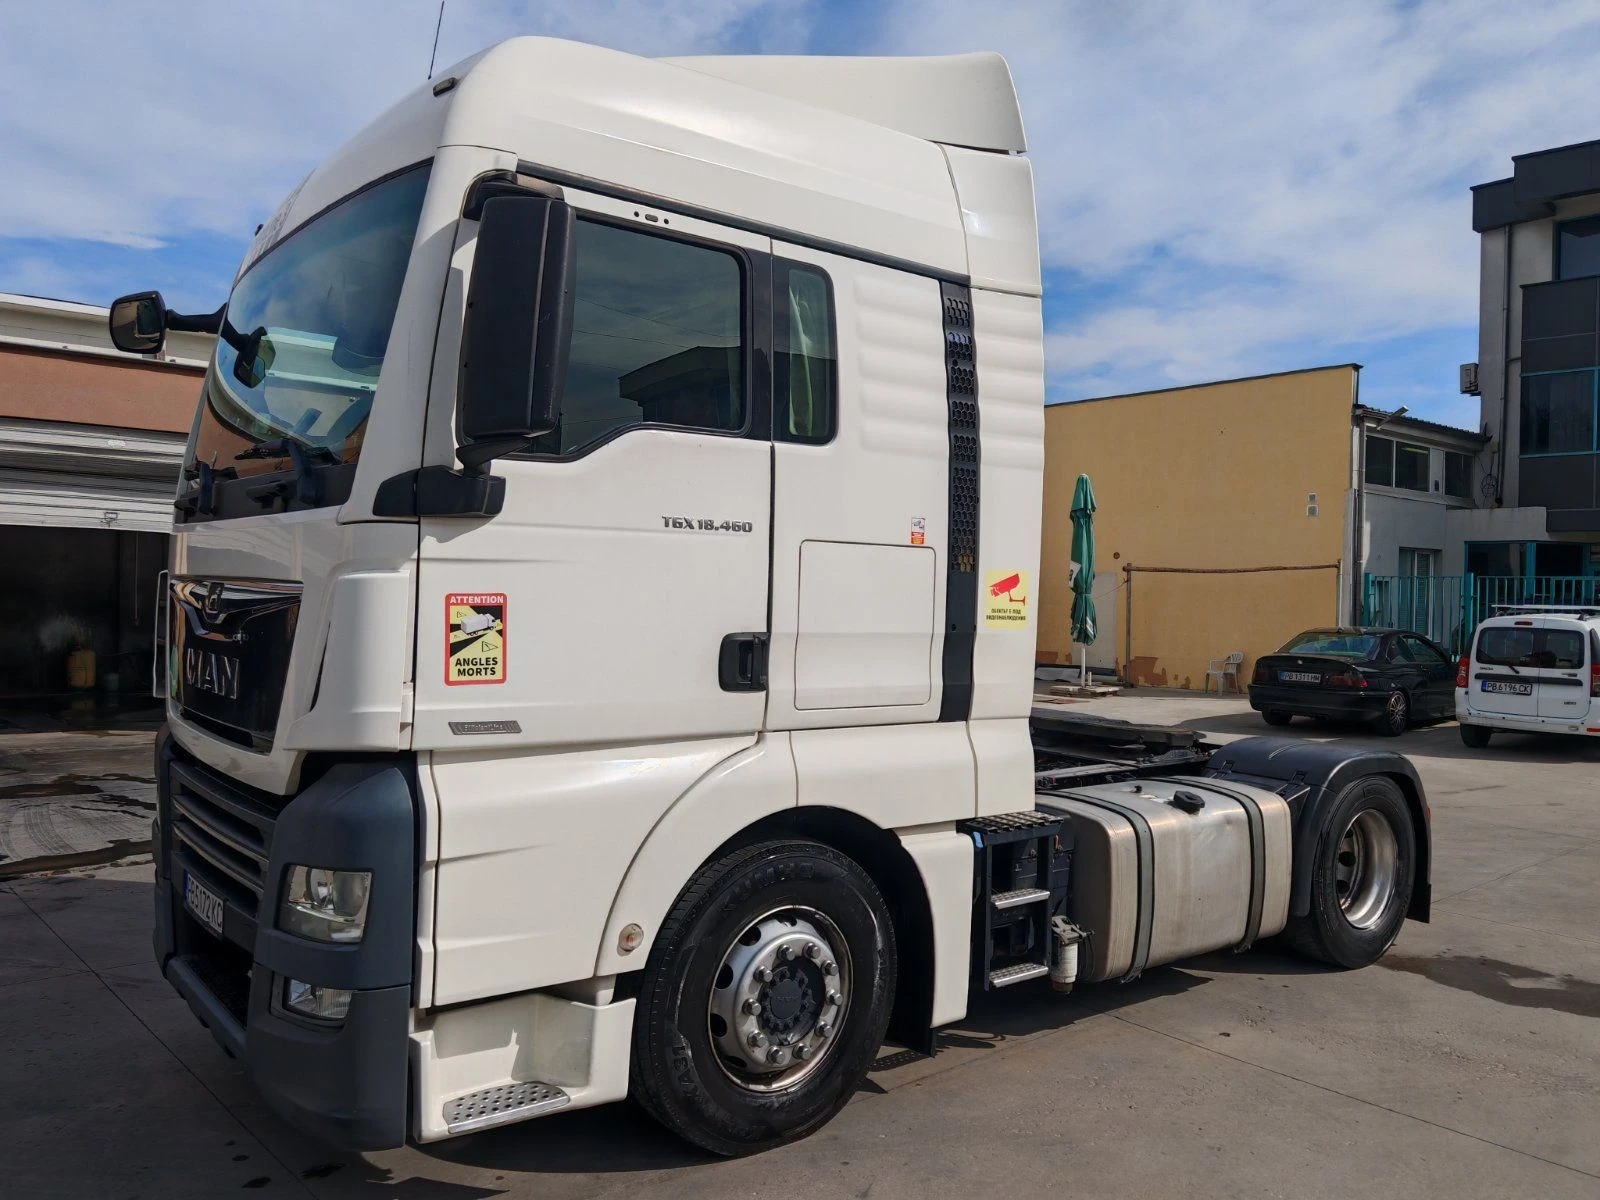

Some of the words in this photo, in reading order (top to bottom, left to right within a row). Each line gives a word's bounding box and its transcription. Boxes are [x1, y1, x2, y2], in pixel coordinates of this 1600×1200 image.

[662, 515, 695, 530] TGX
[697, 519, 753, 533] 18.460
[450, 596, 504, 604] ATTENTION
[455, 657, 499, 667] ANGLES
[186, 648, 240, 700] MAN
[457, 667, 497, 677] MORTS
